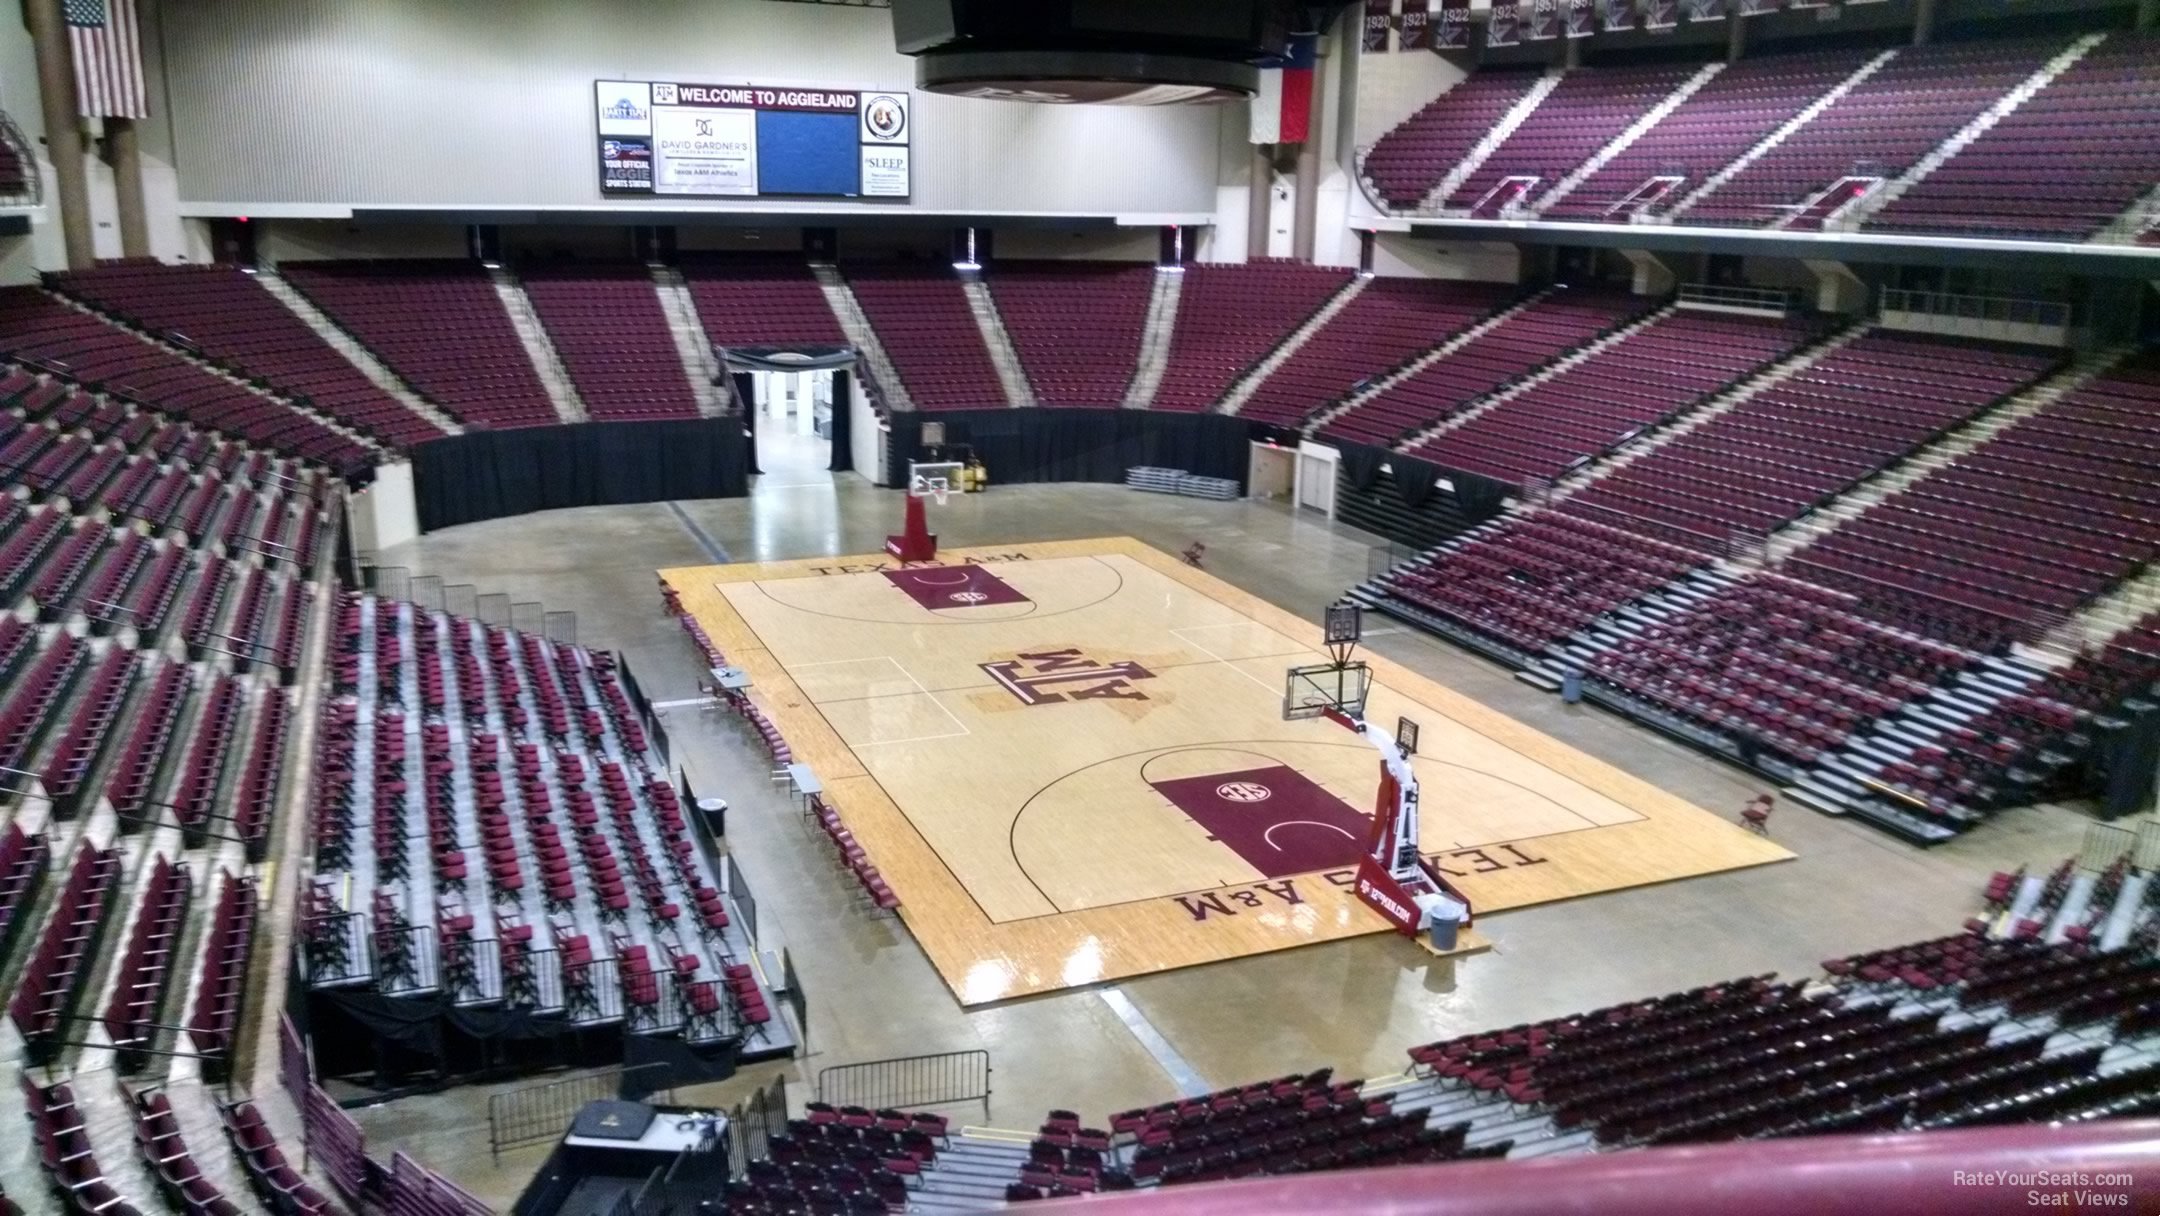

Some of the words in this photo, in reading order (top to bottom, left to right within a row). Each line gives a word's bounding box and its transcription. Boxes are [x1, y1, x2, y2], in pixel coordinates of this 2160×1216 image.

[1443, 8, 1470, 22] 1922
[1492, 5, 1518, 20] 1923
[1366, 16, 1391, 29] 1920
[1402, 13, 1427, 27] 1921
[679, 88, 753, 104] WELCOME
[755, 90, 775, 104] TO
[778, 92, 857, 108] AGGIELAND
[661, 140, 691, 149] DAVID
[694, 141, 748, 150] GARDNER'S
[869, 157, 904, 169] SLEEP
[606, 168, 650, 180] AGGIE
[1173, 880, 1305, 921] A&M
